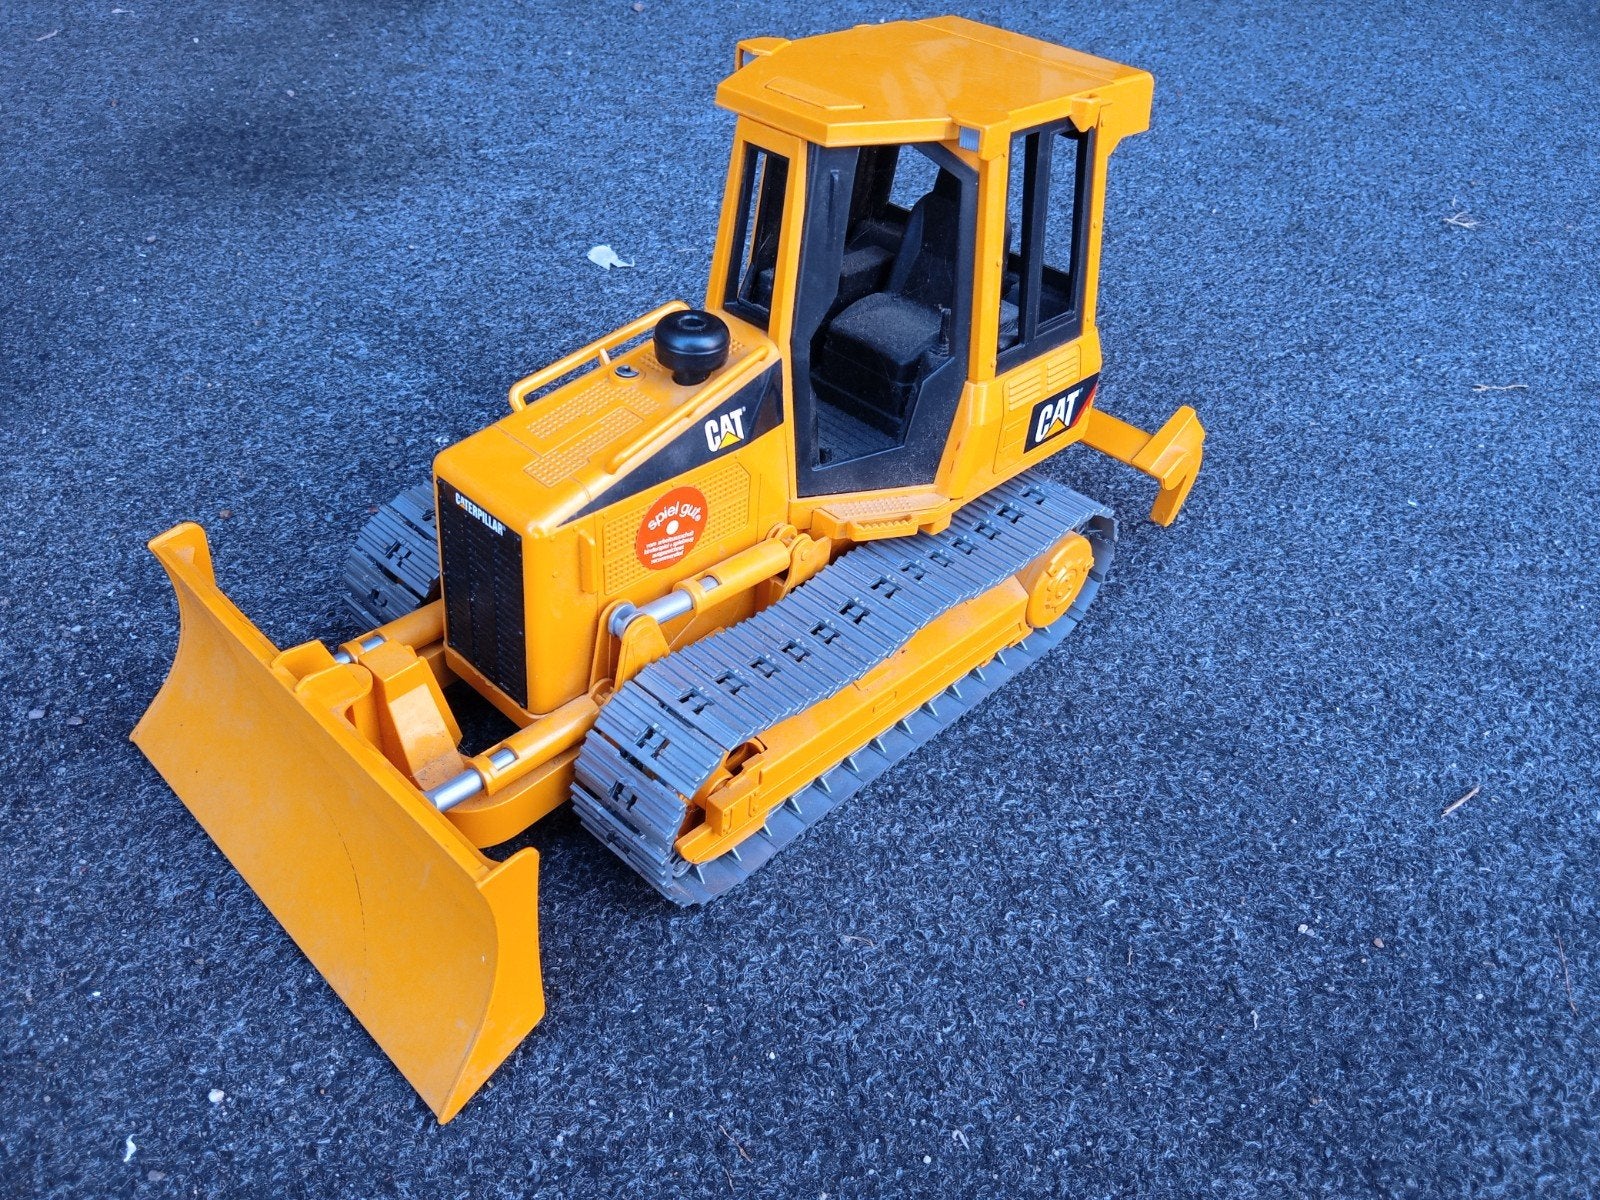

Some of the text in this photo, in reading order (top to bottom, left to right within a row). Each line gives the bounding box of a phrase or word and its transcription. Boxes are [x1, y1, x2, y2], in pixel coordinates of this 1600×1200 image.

[704, 408, 745, 452] CAT
[1035, 390, 1080, 443] CAT
[455, 492, 504, 537] CATERPILLAR
[647, 500, 680, 531] spiel
